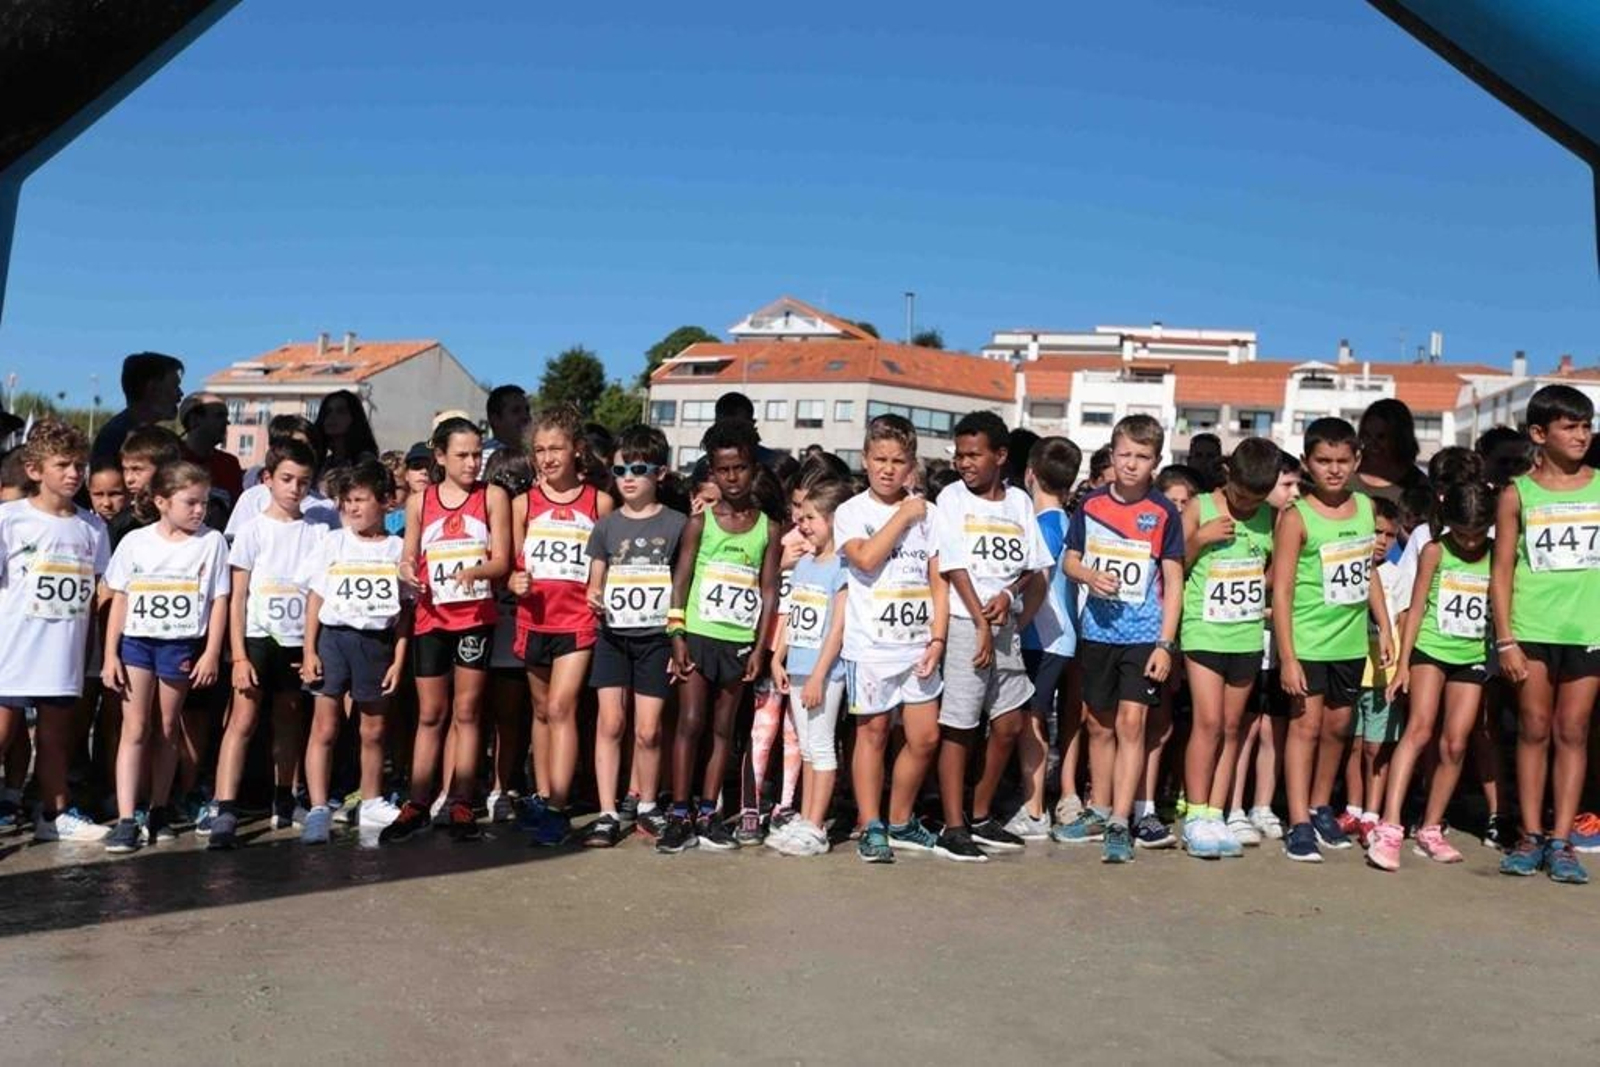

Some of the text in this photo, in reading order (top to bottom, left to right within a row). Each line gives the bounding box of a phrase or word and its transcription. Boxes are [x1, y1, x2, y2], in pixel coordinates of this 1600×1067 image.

[972, 535, 1024, 562] 488
[1535, 525, 1599, 553] 447
[531, 540, 586, 567] 481
[433, 559, 482, 586] 44
[36, 575, 92, 603] 505
[336, 577, 393, 600] 493
[611, 587, 665, 611] 507
[706, 583, 758, 612] 479
[1210, 580, 1262, 606] 455
[133, 594, 191, 619] 489
[268, 597, 303, 620] 50
[786, 604, 818, 631] 09
[879, 601, 929, 627] 464
